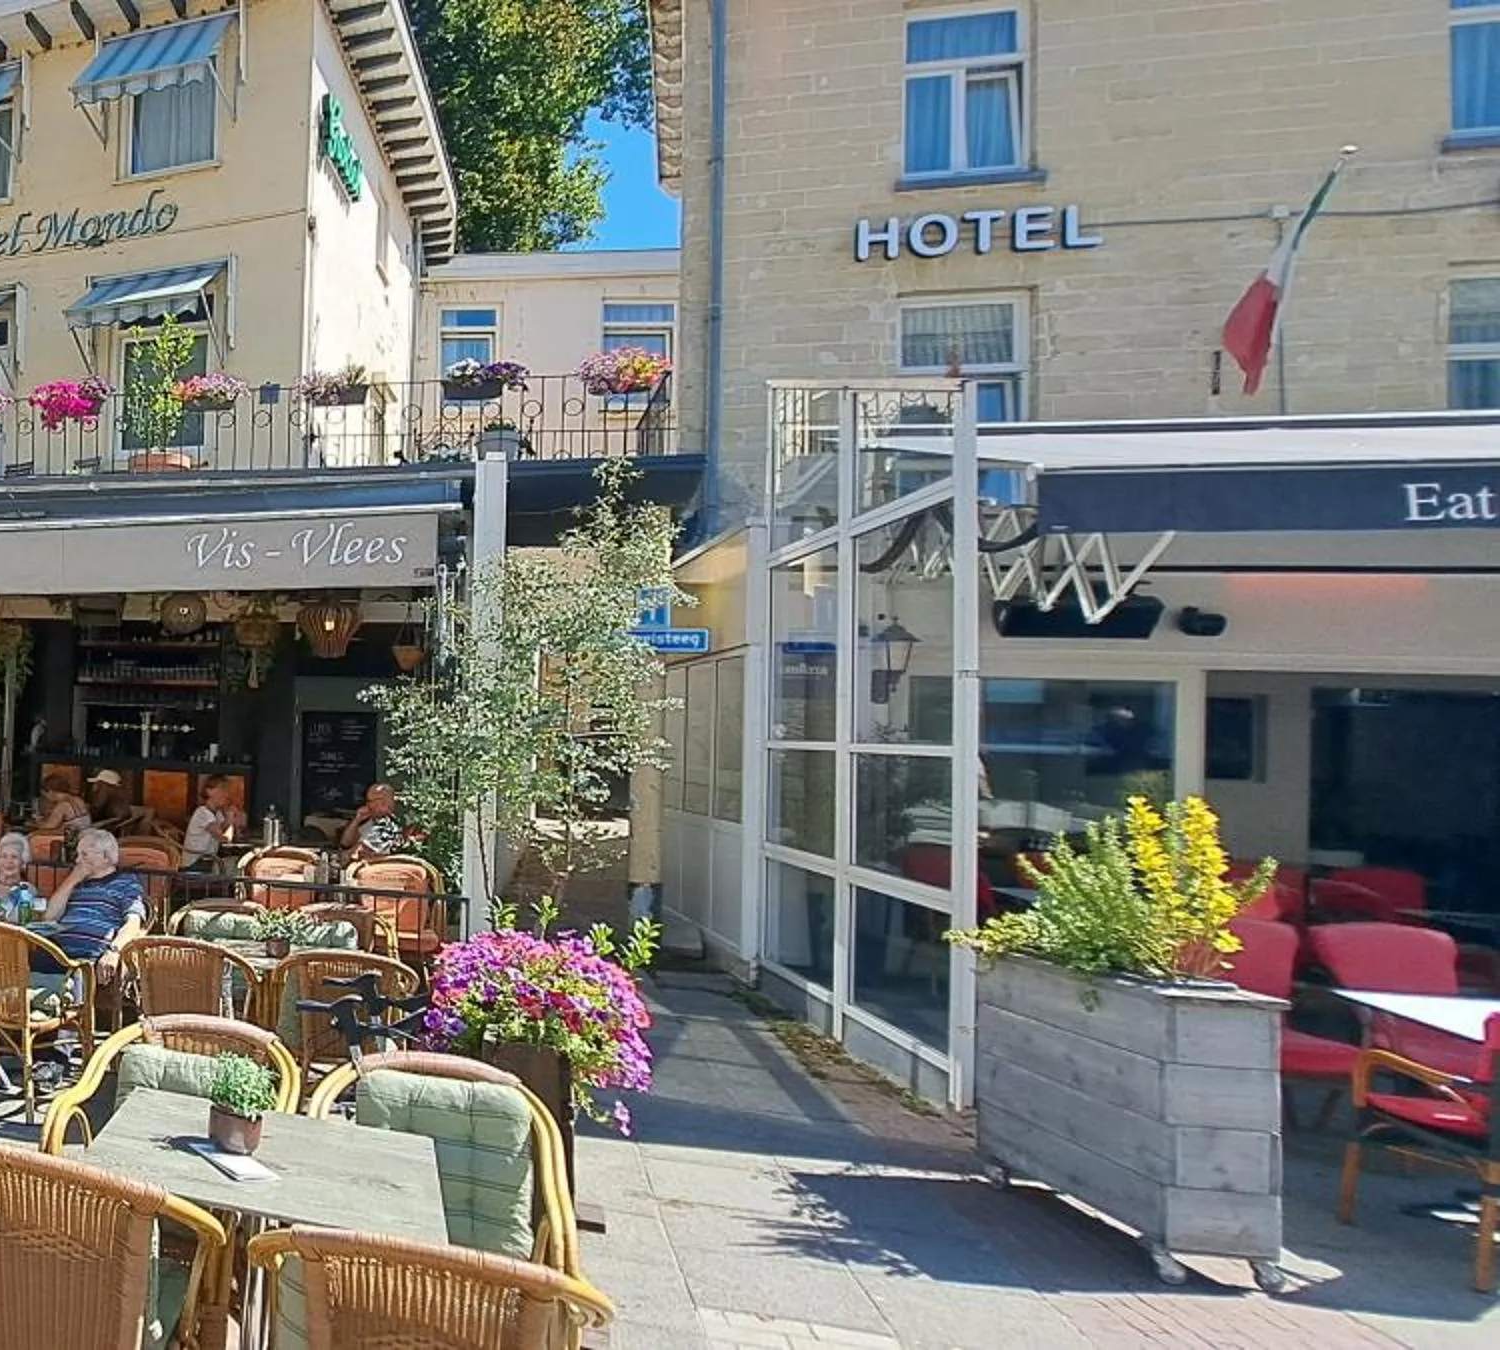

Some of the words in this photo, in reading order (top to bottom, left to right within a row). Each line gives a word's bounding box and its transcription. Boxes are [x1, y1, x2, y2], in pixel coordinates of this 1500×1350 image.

[35, 189, 179, 253] Mondo
[855, 204, 1104, 261] HOTEL
[1402, 483, 1498, 520] Eat
[187, 527, 256, 569] Vis
[291, 522, 407, 566] Vlees
